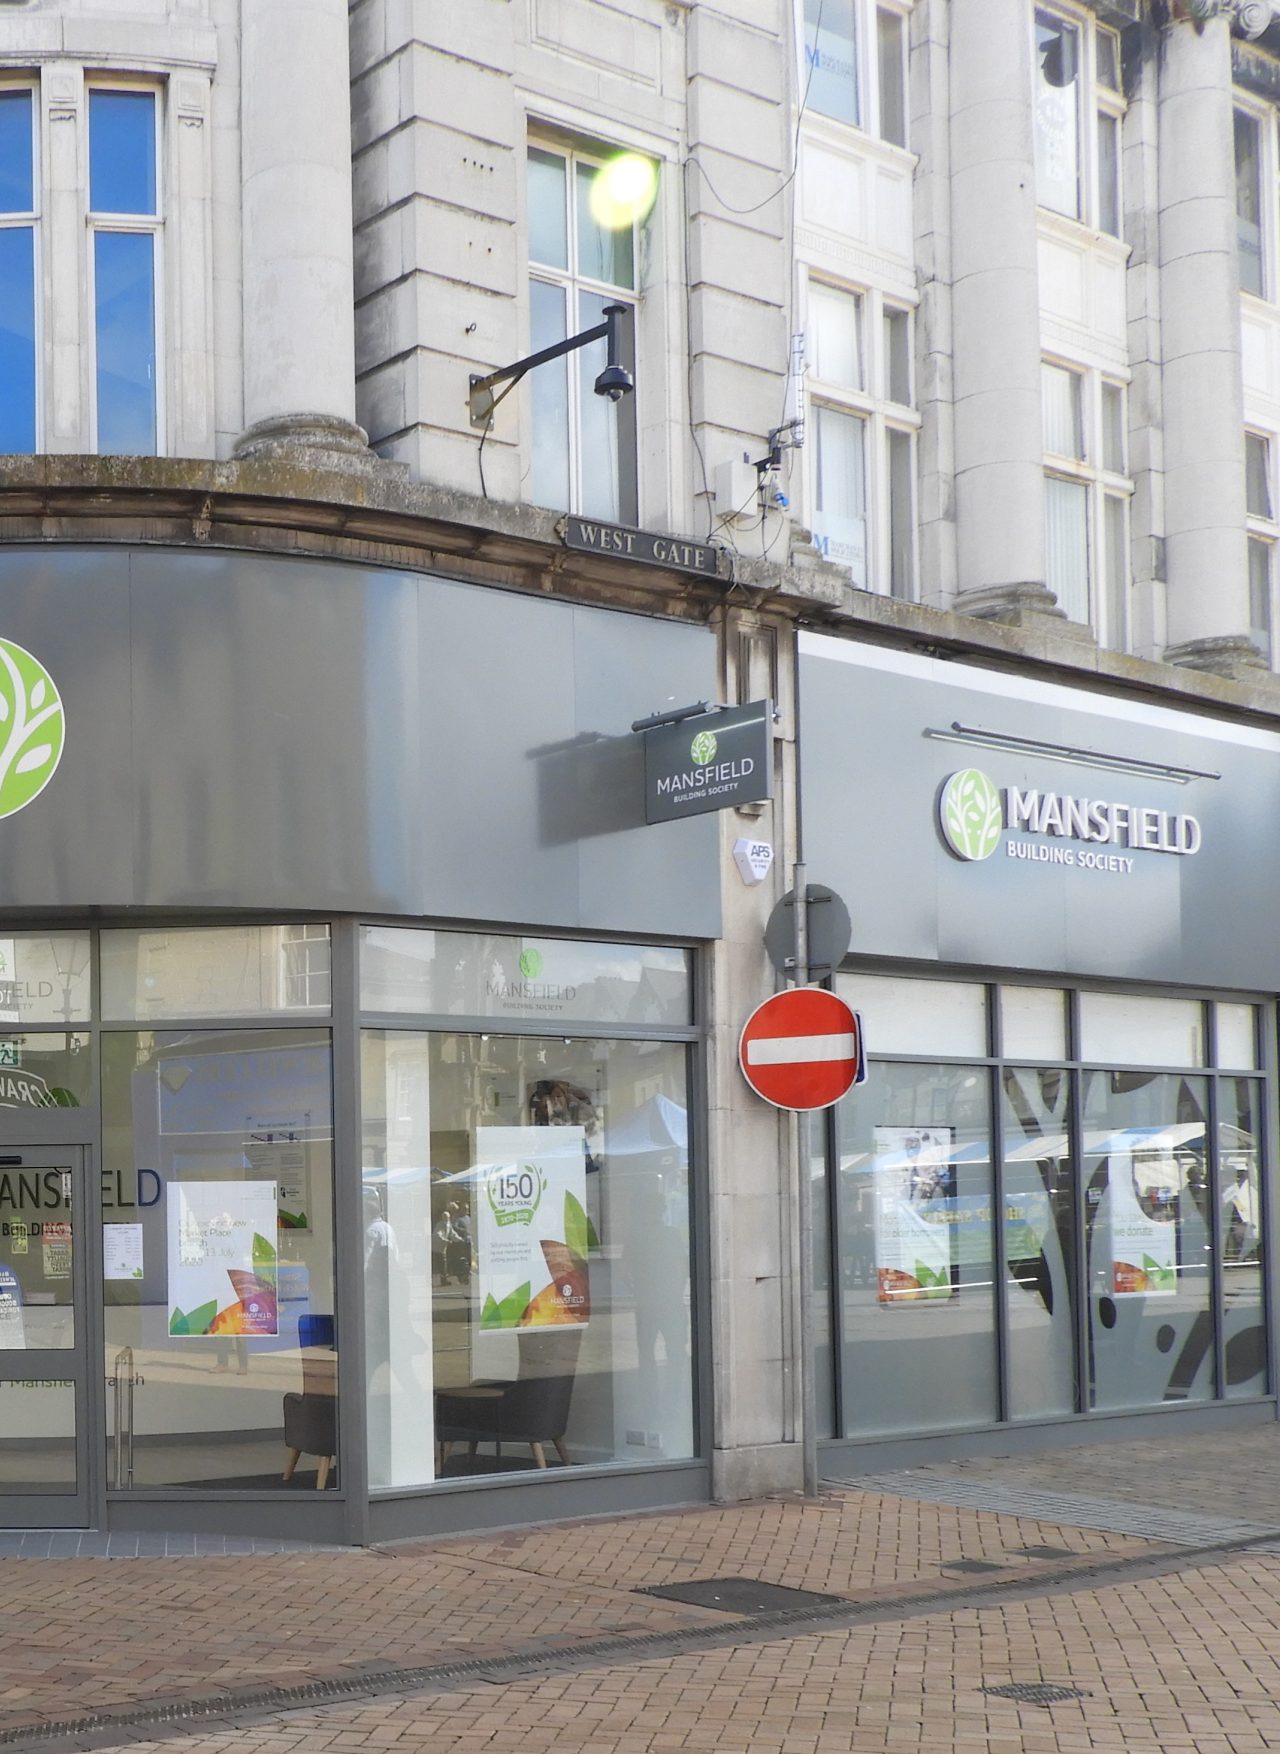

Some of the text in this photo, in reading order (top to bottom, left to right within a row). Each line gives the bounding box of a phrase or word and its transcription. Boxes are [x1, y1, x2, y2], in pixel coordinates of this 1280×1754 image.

[579, 524, 705, 568] WEST GATE
[657, 758, 754, 795] MANSFIELD
[673, 782, 738, 803] BUILDING SOCIETY
[1008, 786, 1201, 855] MANSFIELD
[751, 845, 770, 858] APS
[1008, 841, 1134, 873] BUILDING SOCIETY
[486, 980, 577, 1000] MANSFIELD
[497, 1173, 533, 1200] 150
[550, 1296, 585, 1304] MANSFIELD
